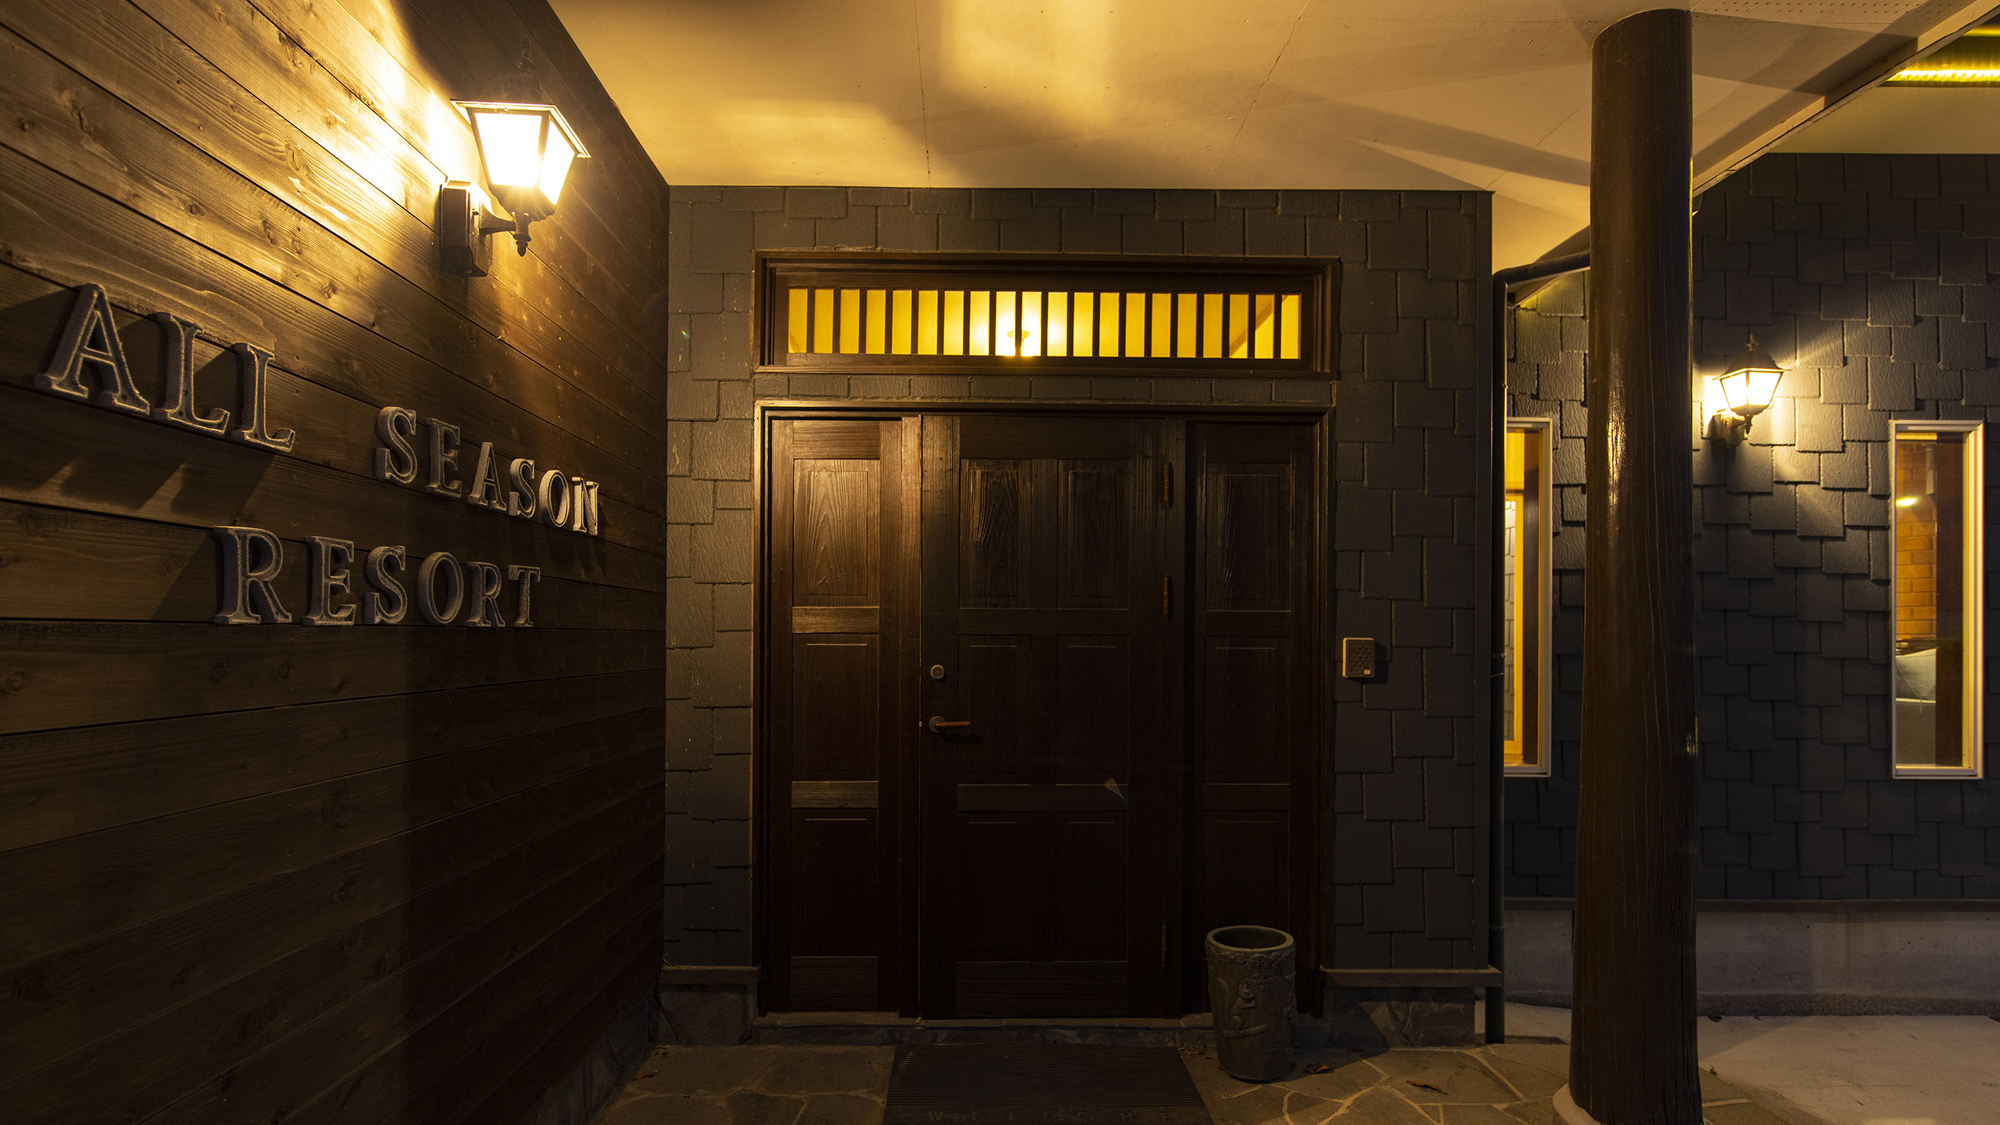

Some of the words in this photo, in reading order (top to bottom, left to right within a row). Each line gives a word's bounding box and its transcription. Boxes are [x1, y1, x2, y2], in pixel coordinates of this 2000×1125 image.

[33, 283, 296, 452] ALL
[375, 406, 599, 536] SEASON
[213, 525, 541, 627] RESORT
[927, 1110, 1170, 1122] WELCOME
